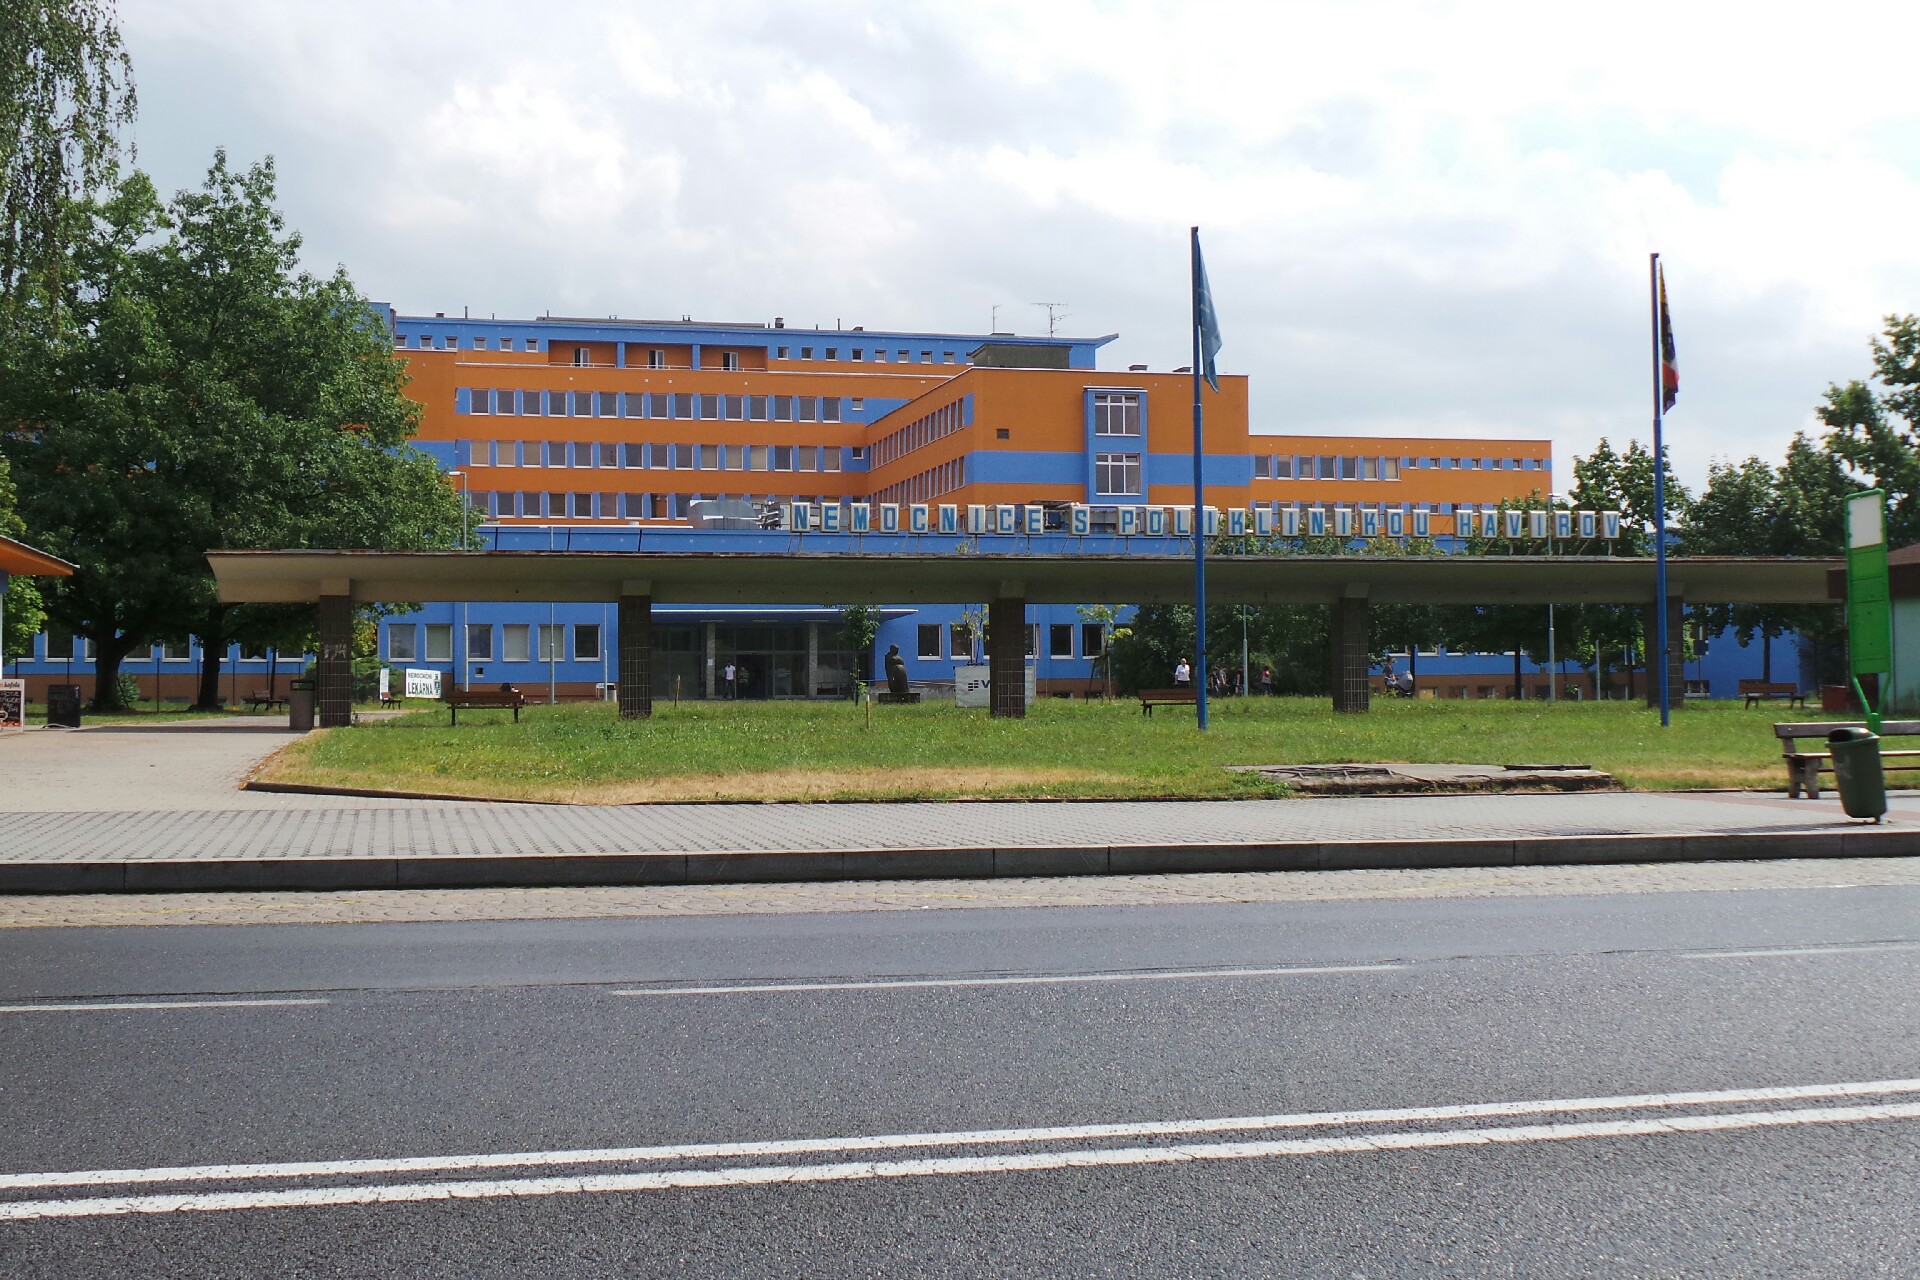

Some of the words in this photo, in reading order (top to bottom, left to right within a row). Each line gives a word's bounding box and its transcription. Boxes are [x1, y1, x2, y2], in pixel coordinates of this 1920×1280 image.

[794, 504, 1042, 533] NEMOCNICE
[1074, 509, 1088, 533] S
[1122, 510, 1429, 536] POLIKLINIKOU
[1460, 513, 1618, 537] HAVIROV
